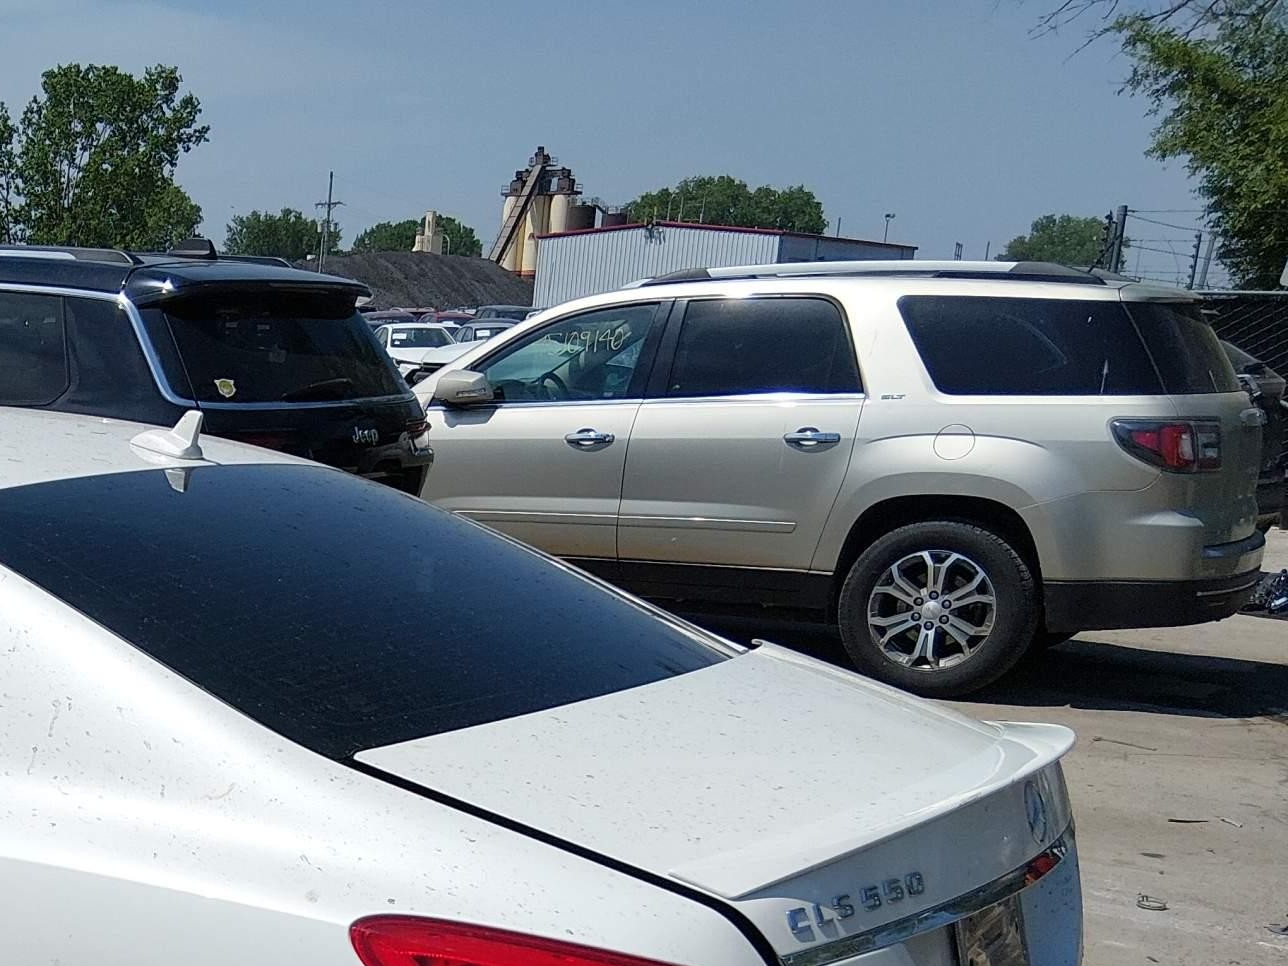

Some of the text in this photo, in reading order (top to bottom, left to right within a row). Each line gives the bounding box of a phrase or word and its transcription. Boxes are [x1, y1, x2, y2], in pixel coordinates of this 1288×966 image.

[352, 425, 380, 447] Jeep
[785, 870, 926, 935] CLS 550
